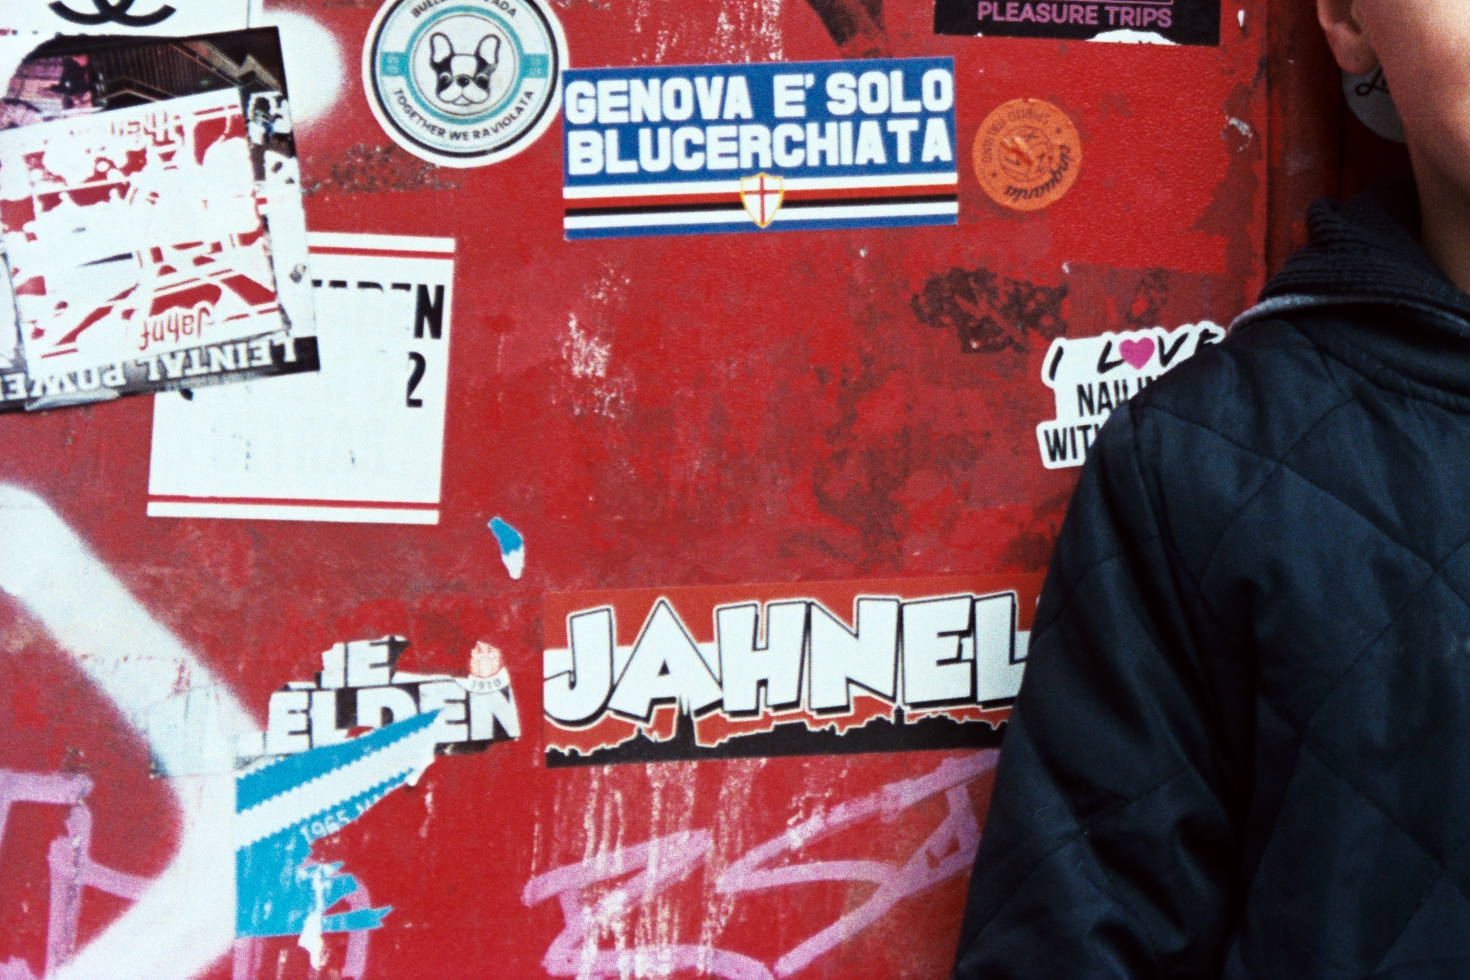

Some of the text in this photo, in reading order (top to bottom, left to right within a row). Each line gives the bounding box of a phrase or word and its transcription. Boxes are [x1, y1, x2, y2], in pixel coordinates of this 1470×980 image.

[977, 1, 1173, 28] PLEASURE TRIPS
[393, 89, 446, 138] TOGETHER
[449, 130, 470, 141] WE
[565, 75, 753, 124] GENOVA
[826, 68, 954, 115] SOLO
[567, 118, 953, 176] BLUCERCHIATA
